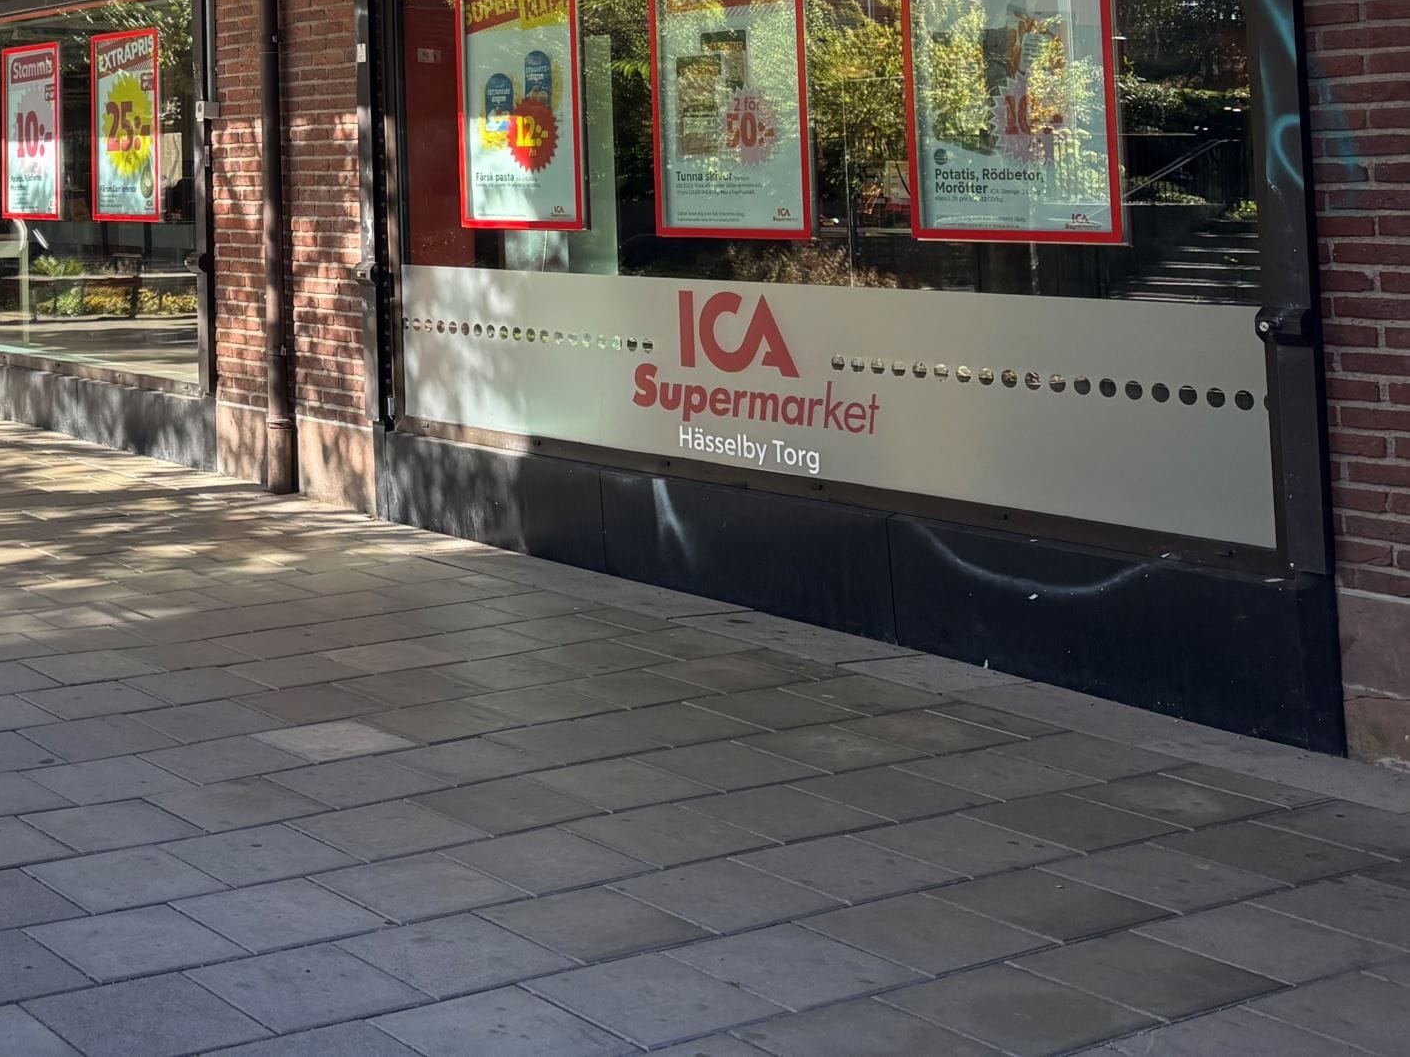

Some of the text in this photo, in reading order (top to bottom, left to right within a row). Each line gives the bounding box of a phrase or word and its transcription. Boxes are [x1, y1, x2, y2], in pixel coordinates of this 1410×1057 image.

[13, 59, 53, 80] Stammis
[98, 35, 153, 72] EXTRAPRIS
[734, 96, 761, 111] 2 för
[16, 110, 53, 158] 10:-
[106, 101, 151, 151] 25:-
[516, 115, 549, 147] 12:-
[726, 112, 775, 148] 50:-
[476, 172, 515, 183] Färsk pasta
[676, 171, 703, 181] Tunna
[935, 168, 1044, 183] Potatis, Rödbetor,
[777, 207, 791, 217] ICA
[678, 290, 801, 379] ICA
[632, 362, 880, 435] Supermarket
[679, 425, 821, 475] Hässelby Torg
